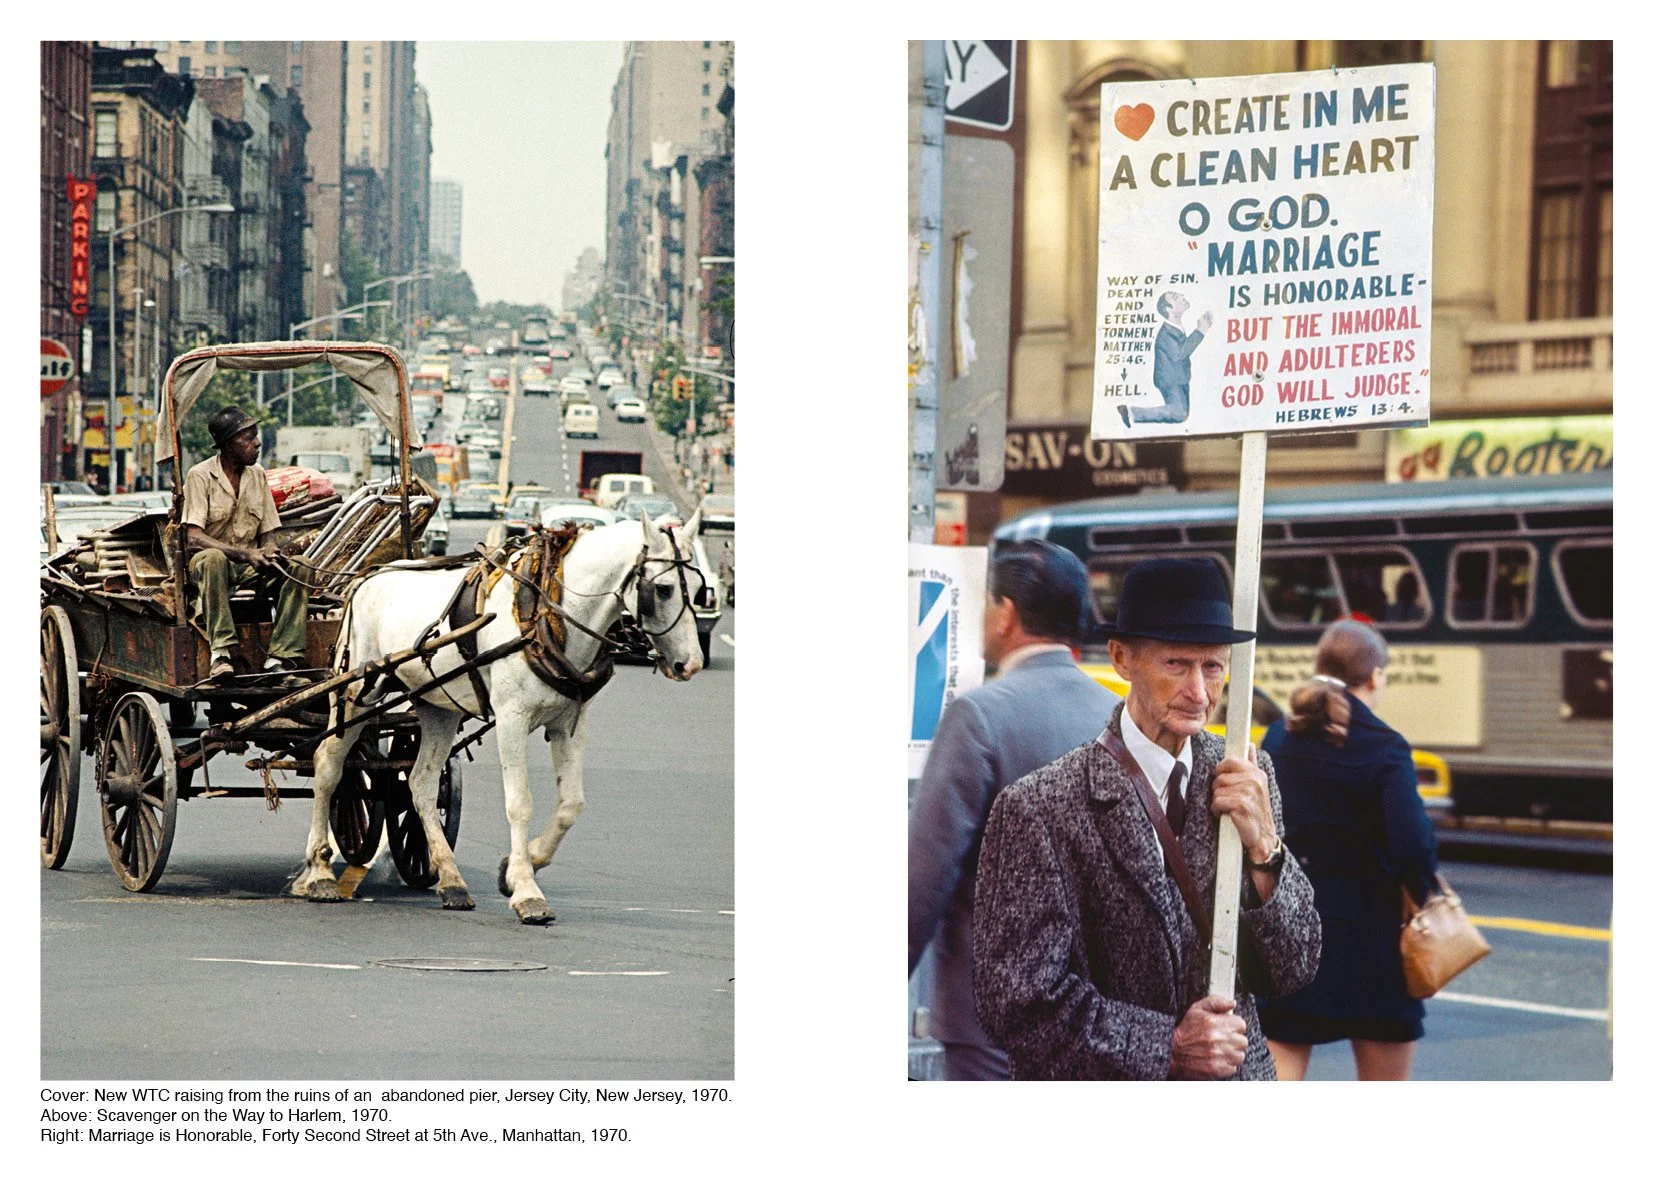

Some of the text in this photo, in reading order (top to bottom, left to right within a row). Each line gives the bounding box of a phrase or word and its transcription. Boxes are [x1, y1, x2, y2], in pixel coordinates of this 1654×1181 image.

[1166, 83, 1410, 137] CREATE IN ME
[1109, 135, 1420, 191] A CLEAN HEART
[1178, 193, 1338, 236] O GOD.
[71, 183, 89, 315] PARKING
[1107, 273, 1199, 286] WAY OF SIN.
[1107, 288, 1153, 298] DEATH
[1228, 284, 1251, 308] IS
[1115, 301, 1144, 311] AND
[1104, 313, 1157, 324] ETERNAL
[1226, 305, 1422, 343] BUT THE IMMORAL
[1103, 341, 1152, 351] MATTHEW
[1223, 339, 1415, 377] AND ADULTERERS
[1104, 384, 1147, 397] HELL.
[1221, 383, 1265, 408] GOD
[1277, 378, 1335, 404] WILL
[1275, 405, 1359, 423] HEBREWS
[951, 588, 959, 606] the
